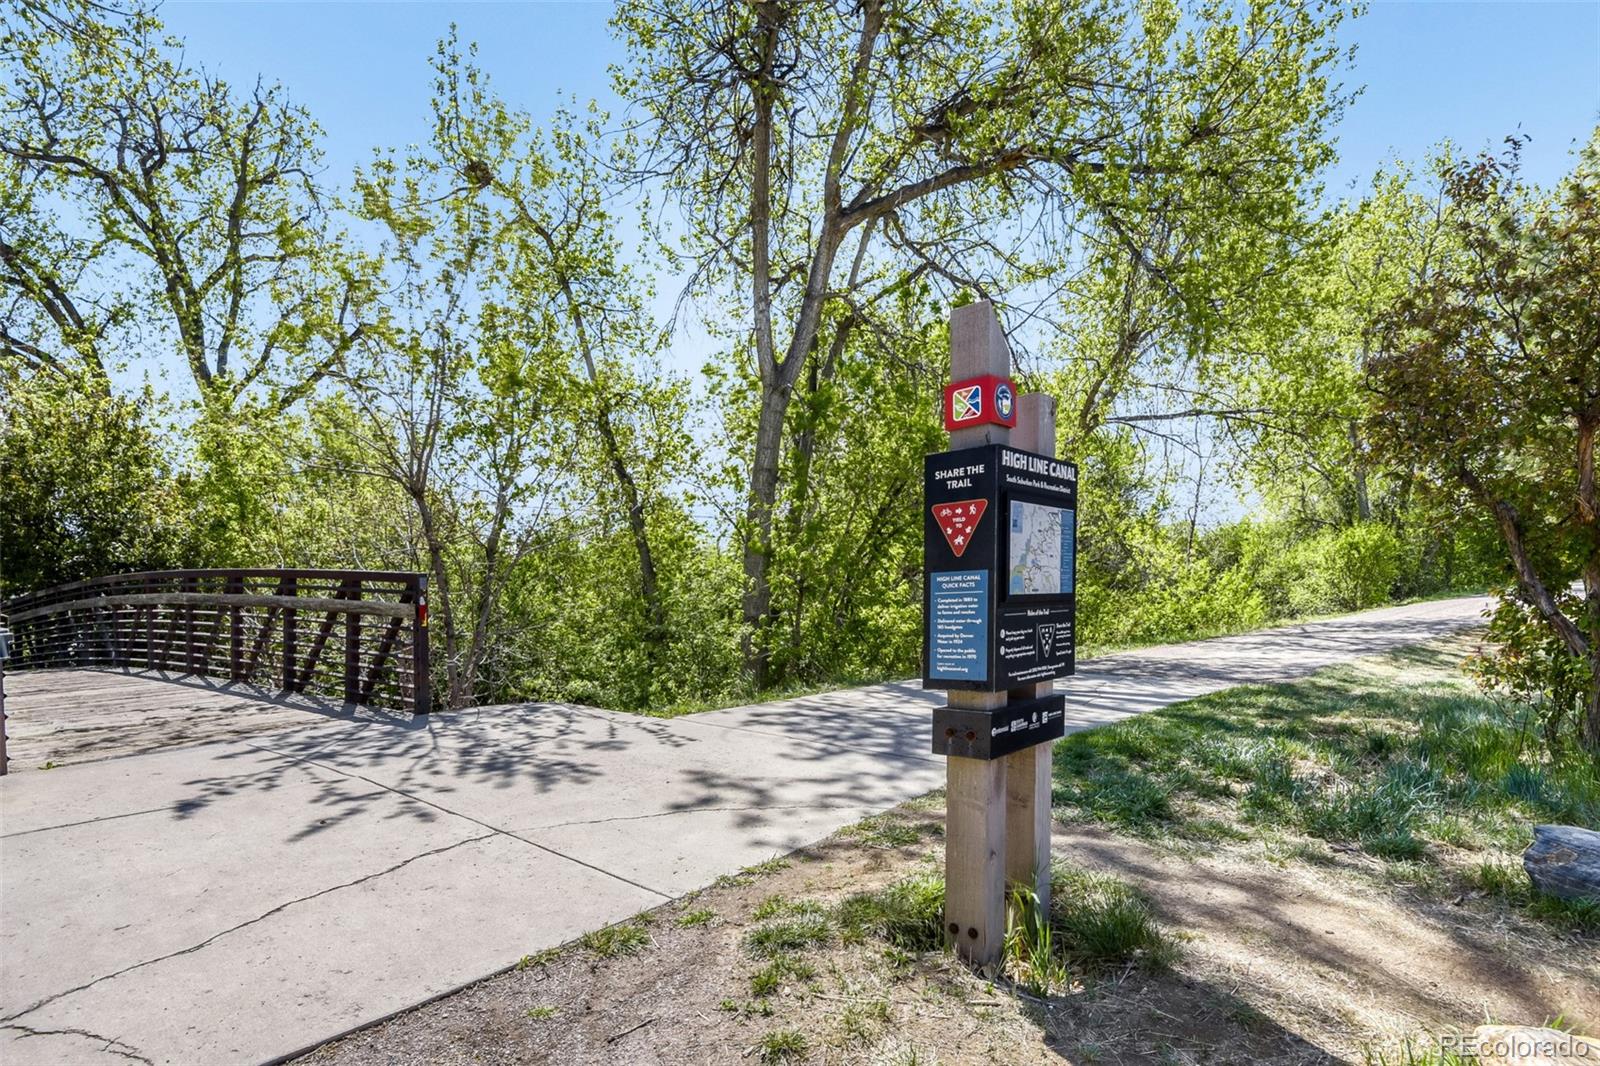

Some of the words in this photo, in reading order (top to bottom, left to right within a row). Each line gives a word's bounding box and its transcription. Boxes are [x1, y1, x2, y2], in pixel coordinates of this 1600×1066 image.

[935, 468, 965, 479] SHARE
[967, 464, 985, 474] THE
[1002, 450, 1027, 470] HIGH
[1028, 457, 1048, 475] LINE
[1049, 462, 1076, 481] CANAL
[947, 478, 972, 489] TRAIL
